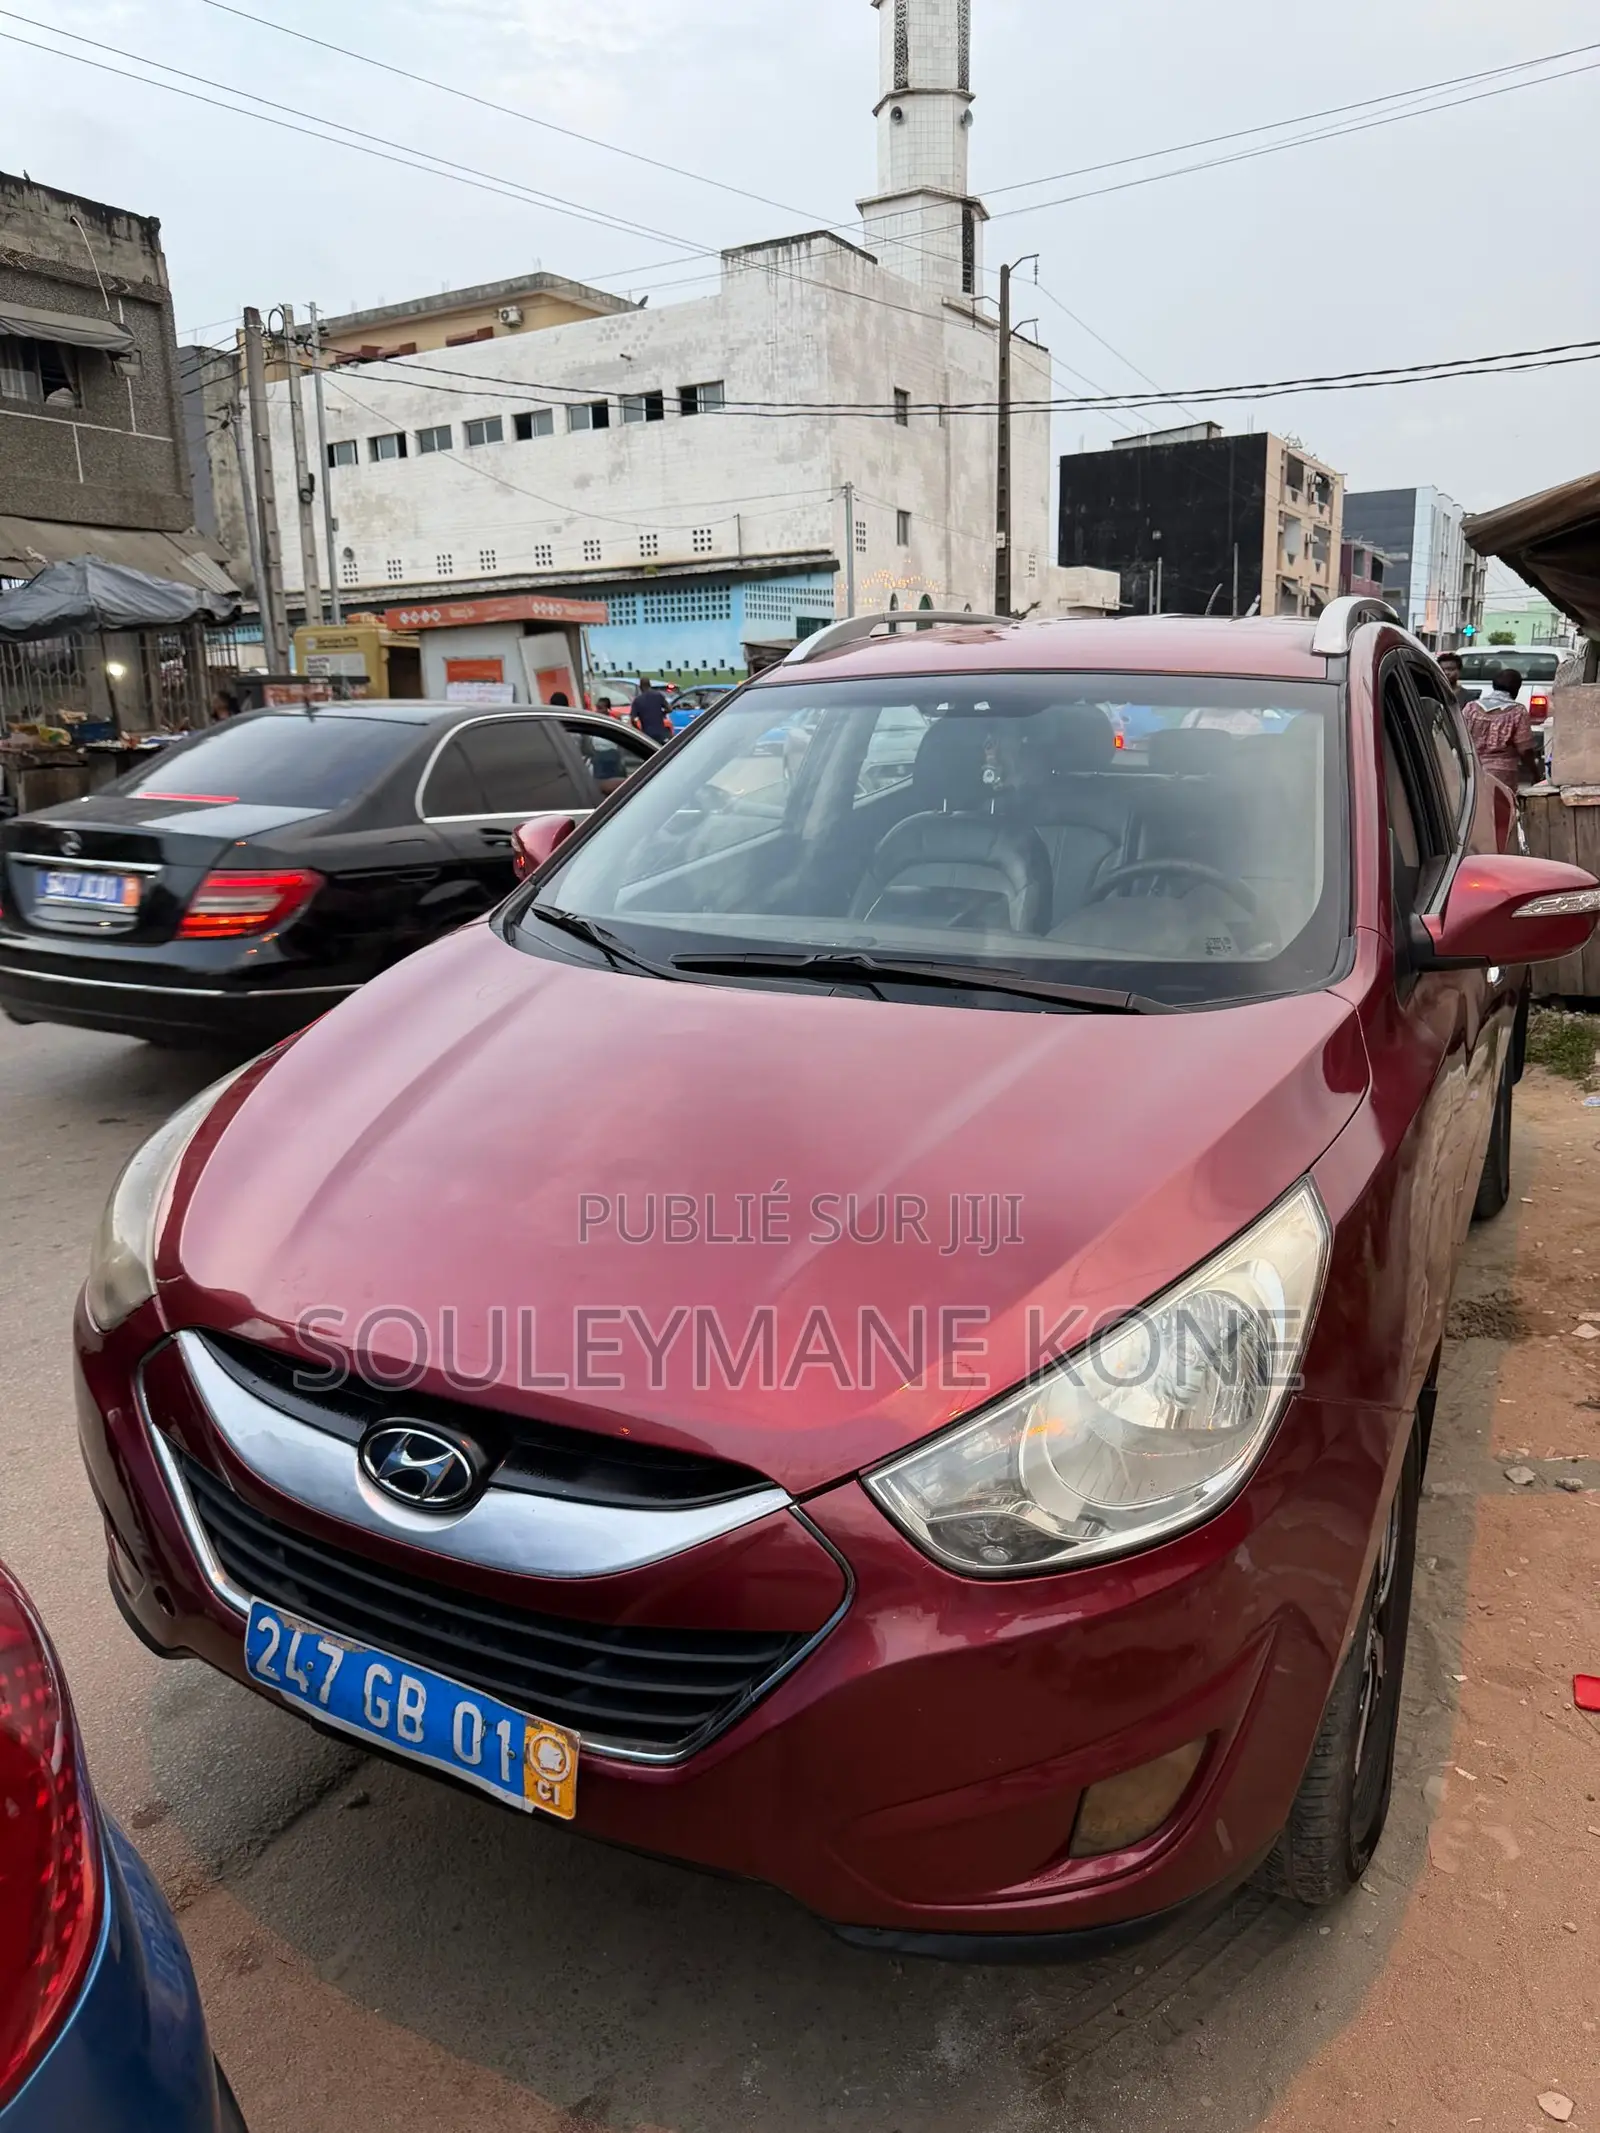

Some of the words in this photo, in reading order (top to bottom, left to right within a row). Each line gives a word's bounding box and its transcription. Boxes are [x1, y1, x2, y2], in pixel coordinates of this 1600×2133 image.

[256, 1616, 345, 1704] 247
[364, 1663, 427, 1743] GB
[452, 1700, 512, 1783] 01
[537, 1779, 560, 1805] CI
